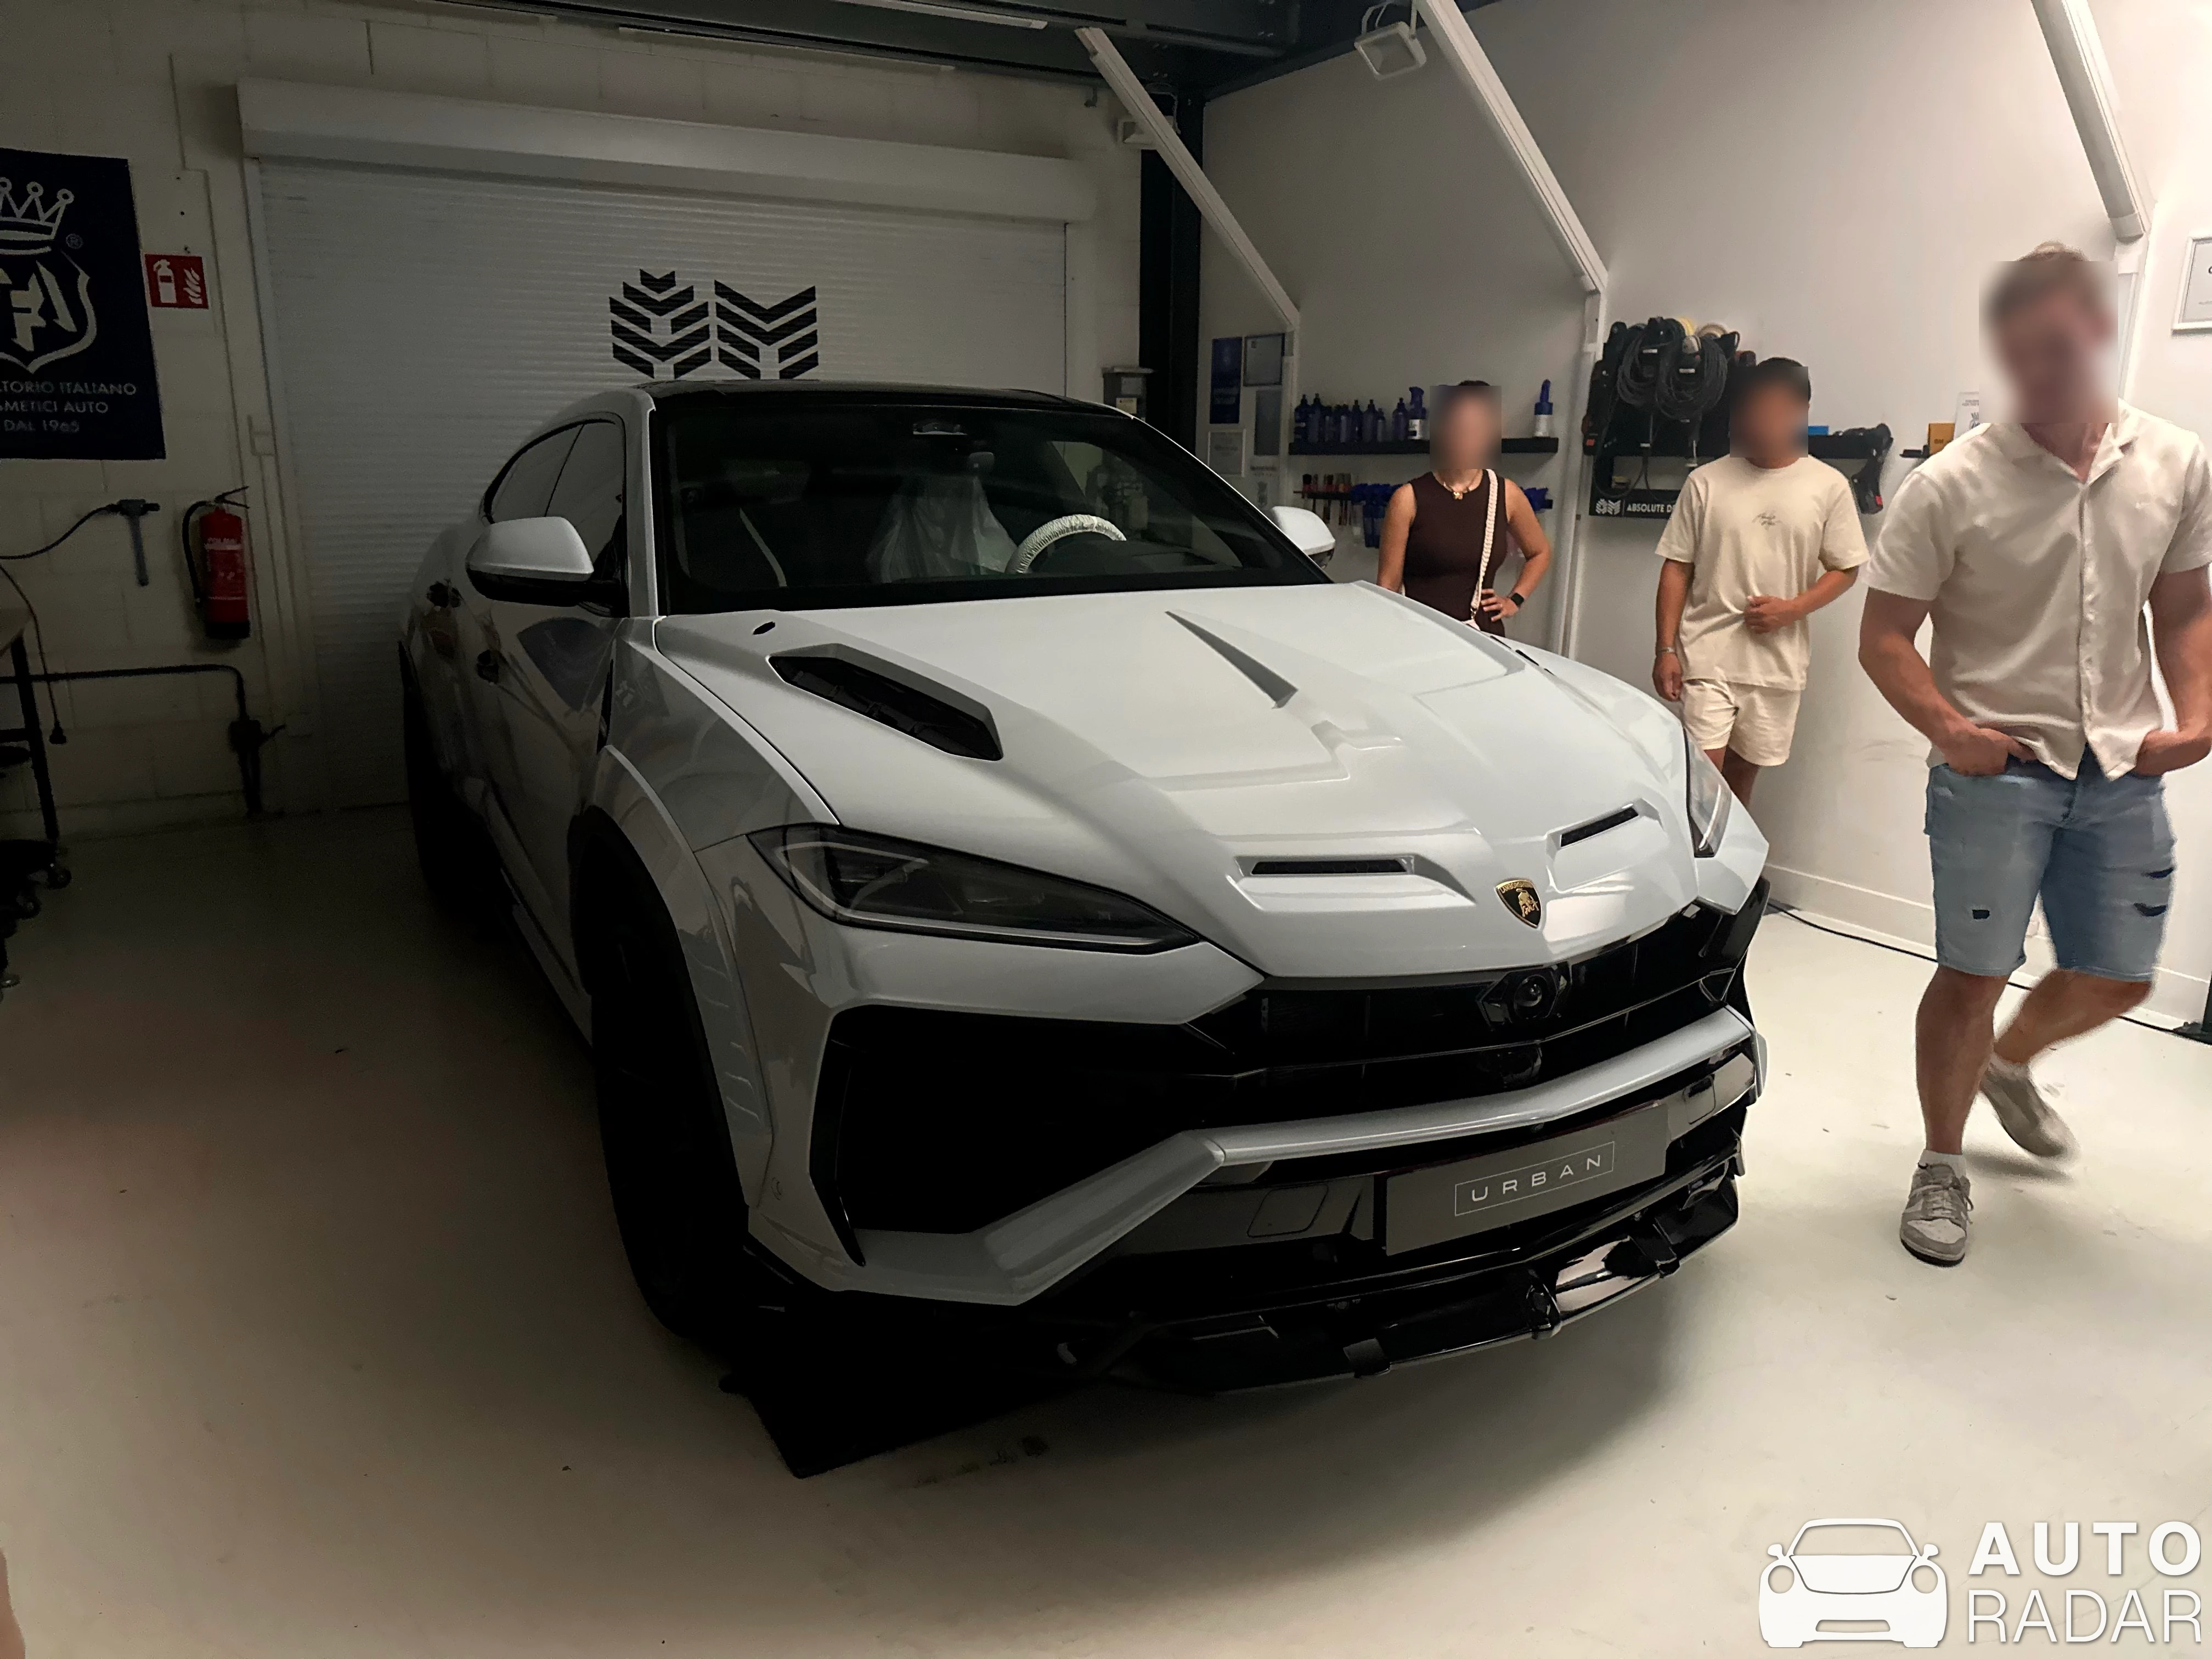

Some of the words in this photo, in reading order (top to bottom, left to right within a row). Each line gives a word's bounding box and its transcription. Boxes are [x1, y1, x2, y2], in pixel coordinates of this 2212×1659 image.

[0, 381, 54, 393] TORIO
[59, 382, 137, 395] ITALIANO
[64, 401, 109, 413] AUTO
[4, 419, 36, 432] DAL
[1626, 503, 1664, 513] ABSOLUTE
[1472, 1154, 1601, 1201] URBAN
